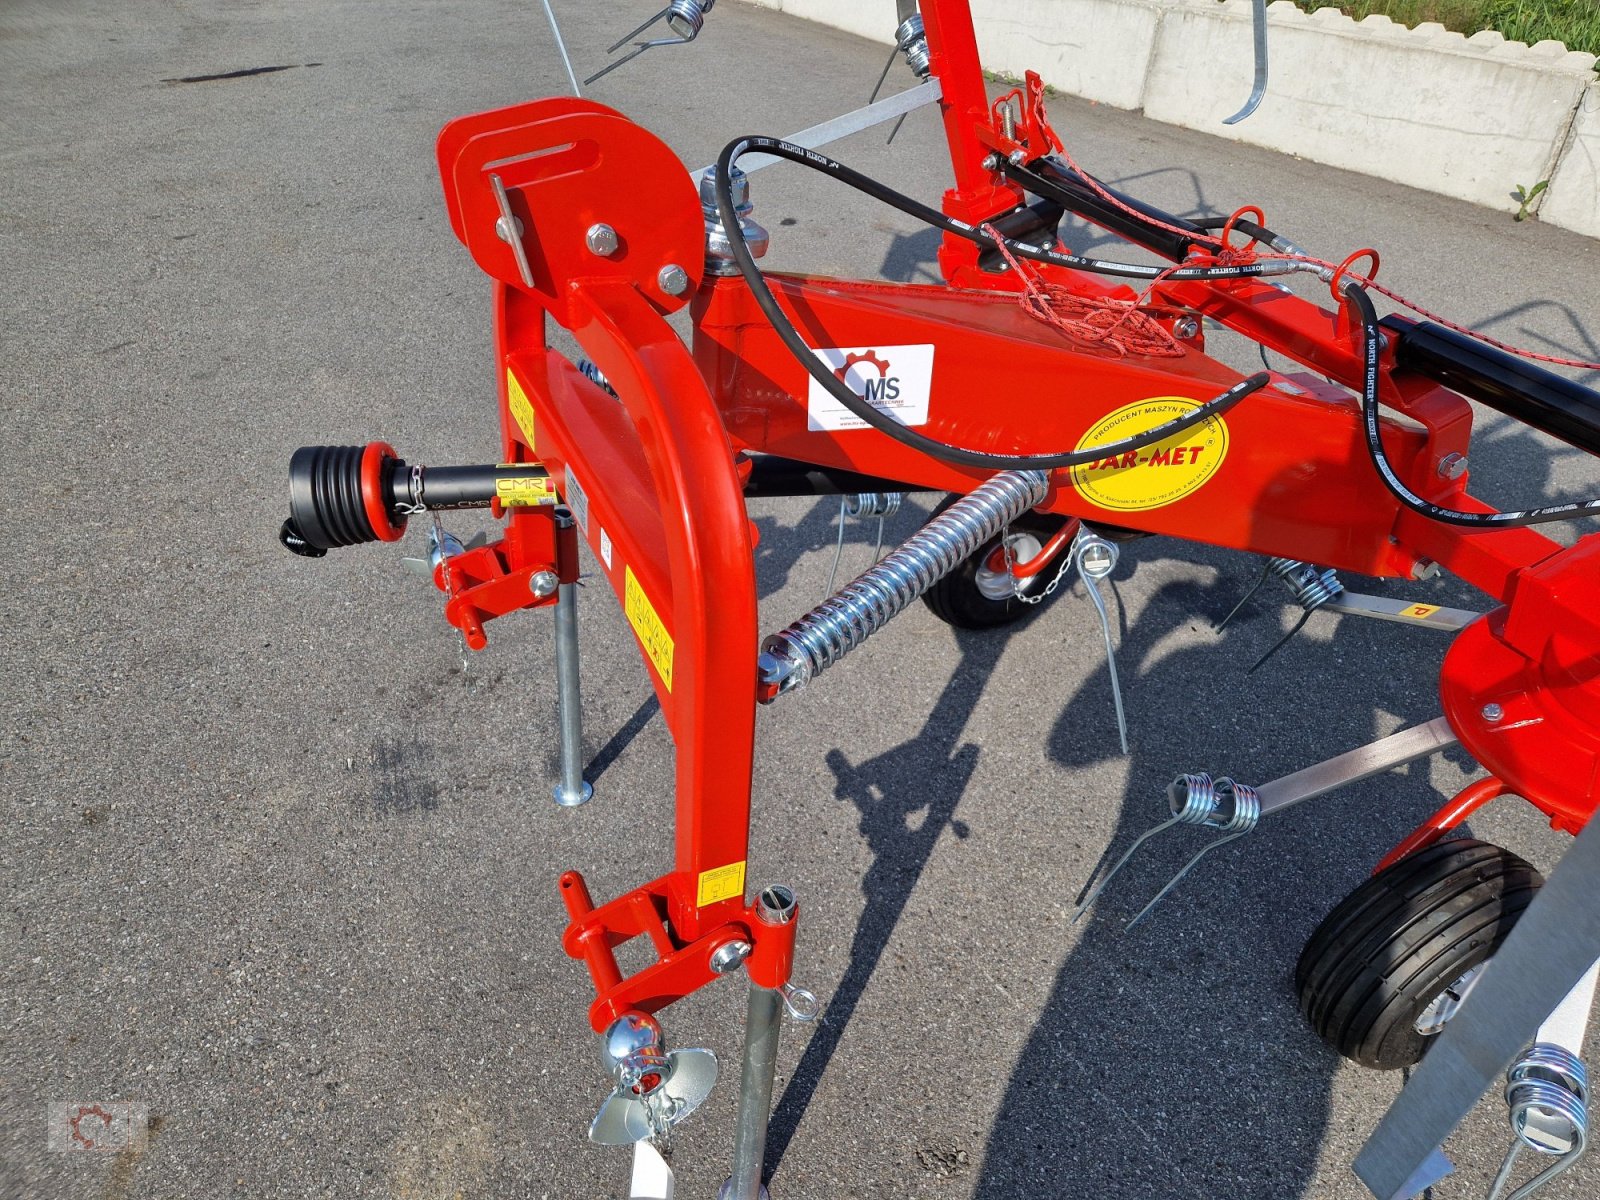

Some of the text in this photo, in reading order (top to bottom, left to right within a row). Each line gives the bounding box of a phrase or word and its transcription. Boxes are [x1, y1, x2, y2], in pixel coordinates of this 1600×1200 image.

[806, 150, 827, 165] NORTH
[1368, 338, 1376, 364] NORTH
[864, 376, 901, 401] MS
[1093, 410, 1142, 441] PRODUCENT
[1144, 405, 1178, 414] MASZYN
[1088, 445, 1205, 470] JAR-MET
[497, 478, 543, 491] CMR
